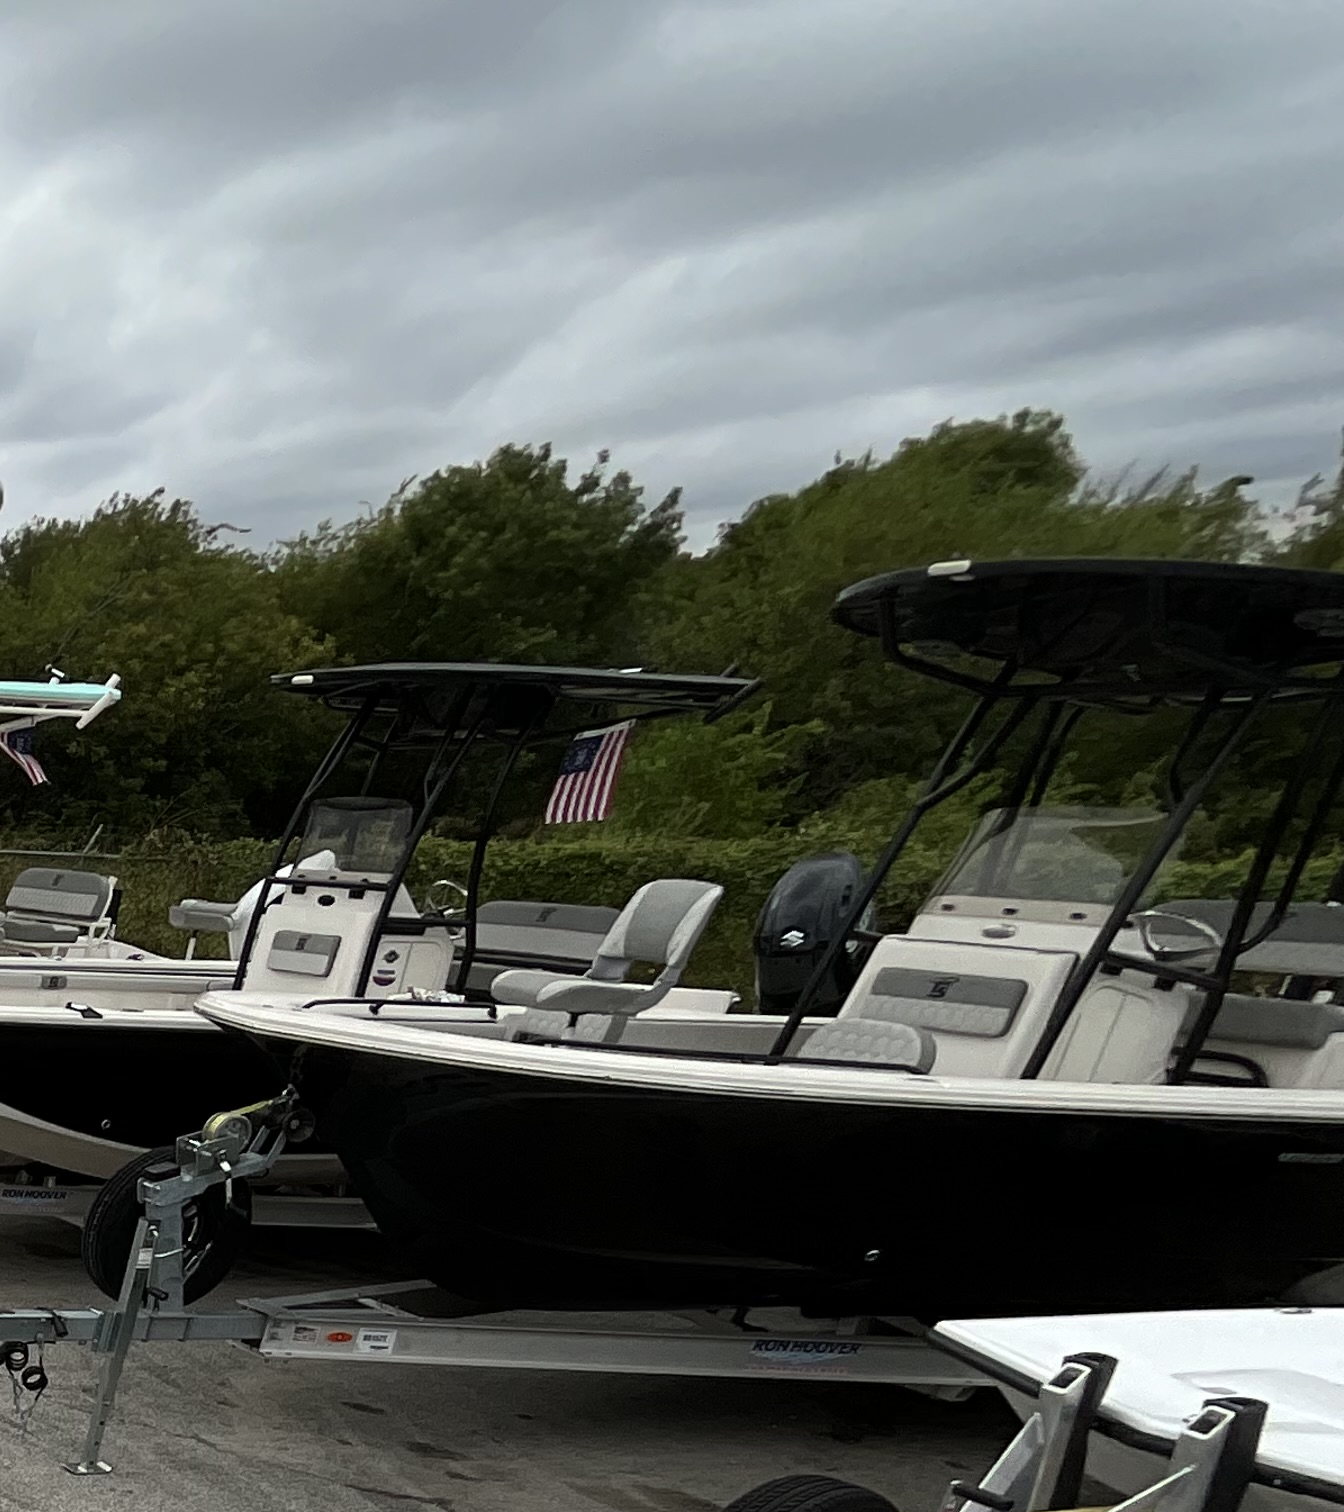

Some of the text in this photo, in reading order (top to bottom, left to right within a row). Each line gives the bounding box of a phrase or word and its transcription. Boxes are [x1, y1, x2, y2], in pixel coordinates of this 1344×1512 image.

[1, 1189, 24, 1198] RON
[752, 1340, 862, 1354] RON HOOVER
